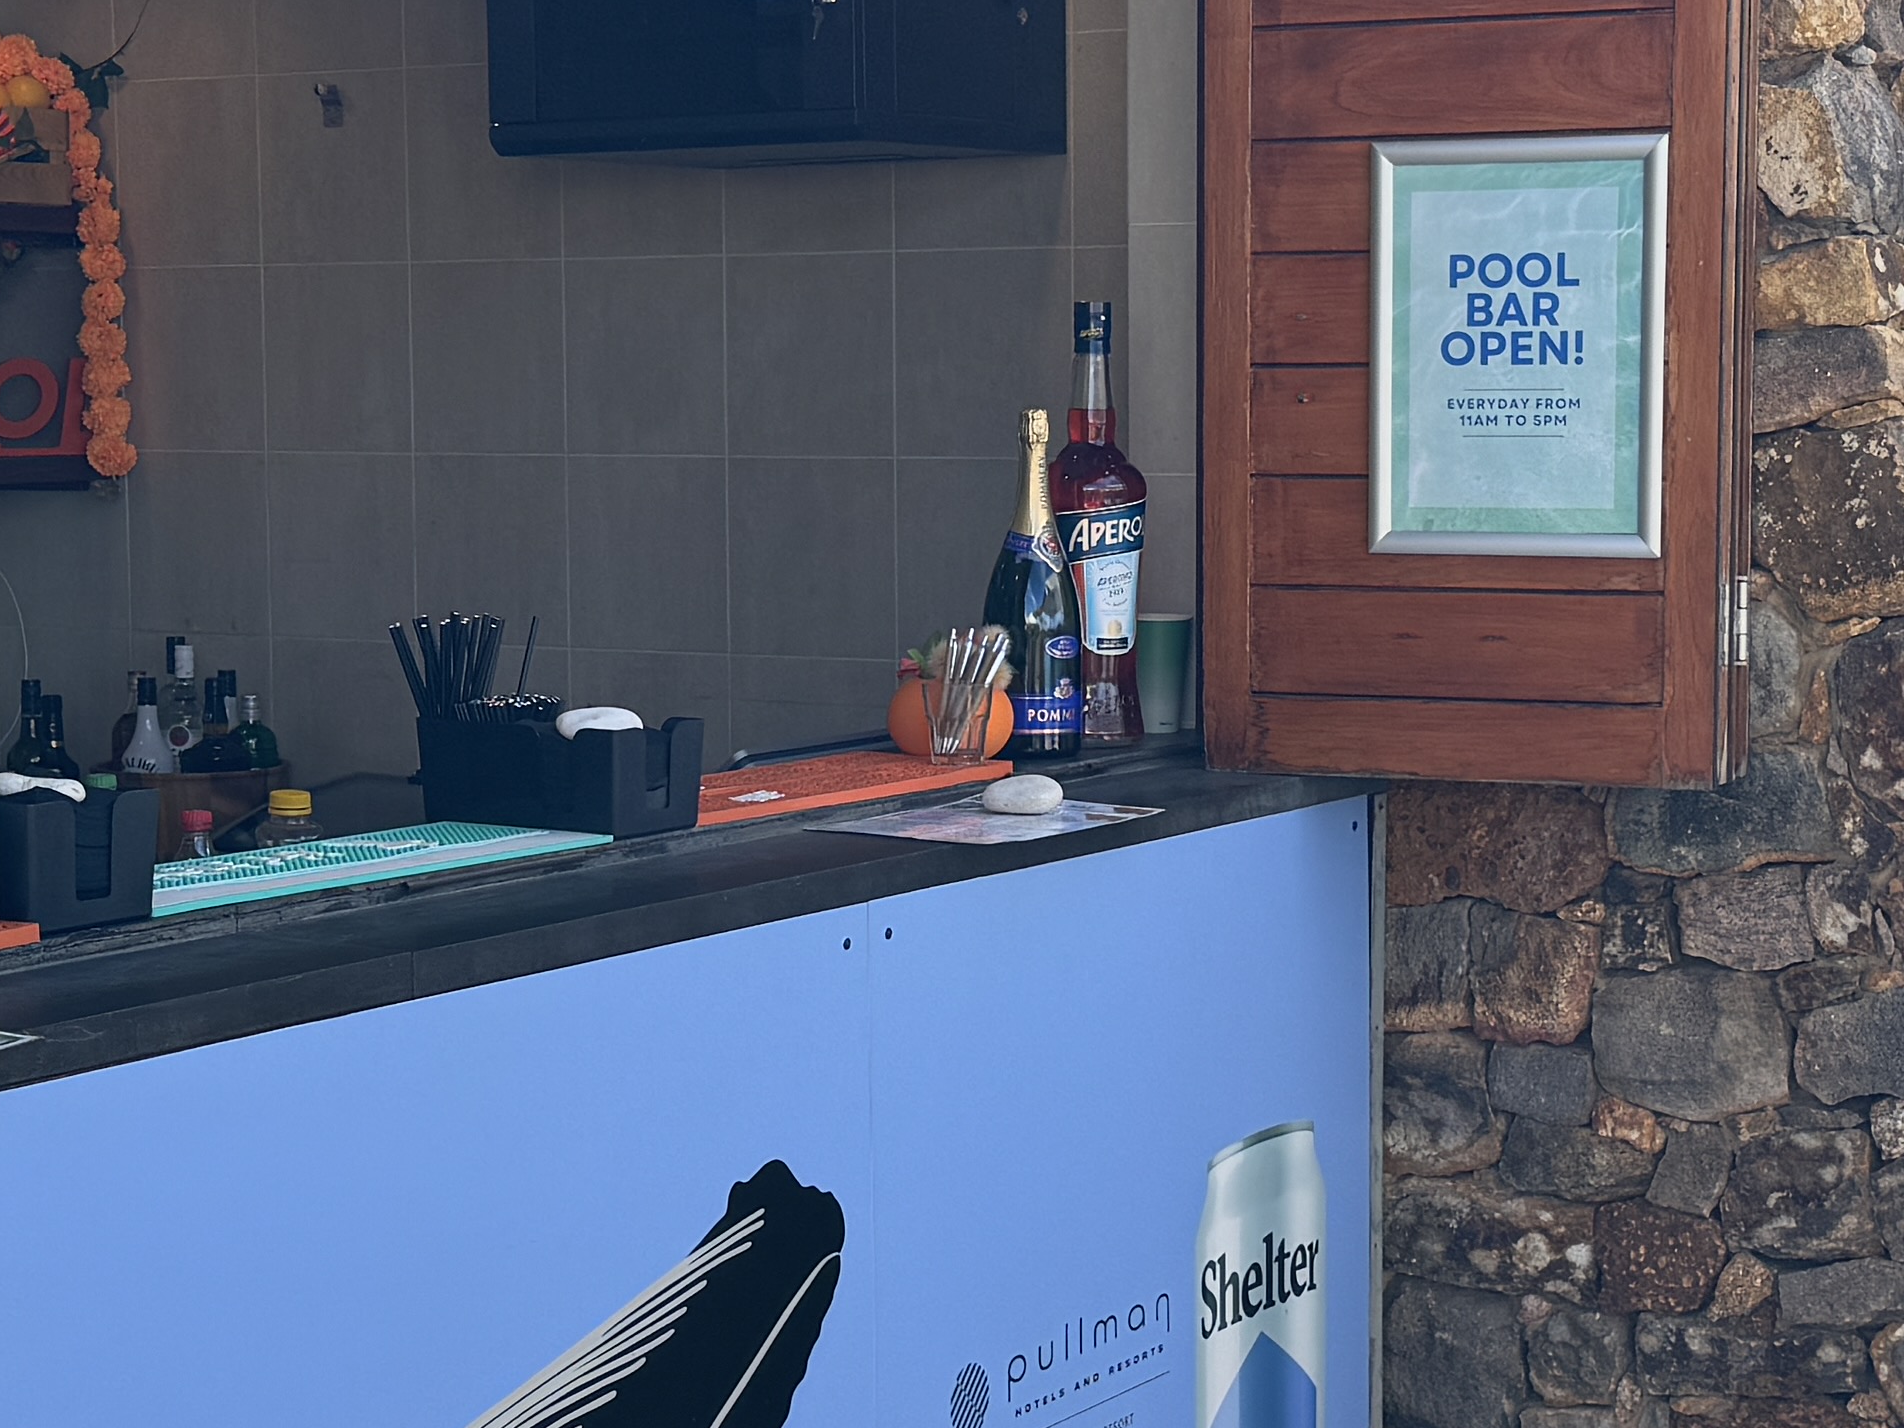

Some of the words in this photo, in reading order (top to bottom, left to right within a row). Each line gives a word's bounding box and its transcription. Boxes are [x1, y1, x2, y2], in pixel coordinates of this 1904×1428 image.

[1448, 251, 1580, 288] POOL
[1466, 291, 1559, 327] BAR
[1440, 329, 1584, 367] OPEN!
[1447, 397, 1530, 410] EVERYDAY
[1535, 396, 1581, 410] FROM
[1458, 414, 1499, 427] 11AM
[1504, 414, 1528, 427] TO
[1532, 414, 1568, 427] 5PM
[1068, 516, 1143, 553] APERO
[1199, 1231, 1320, 1340] Shelter
[1007, 1292, 1170, 1403] pullman
[1014, 1388, 1066, 1419] HOTELS
[1073, 1372, 1100, 1392] AND
[1108, 1343, 1165, 1376] RESORTS
